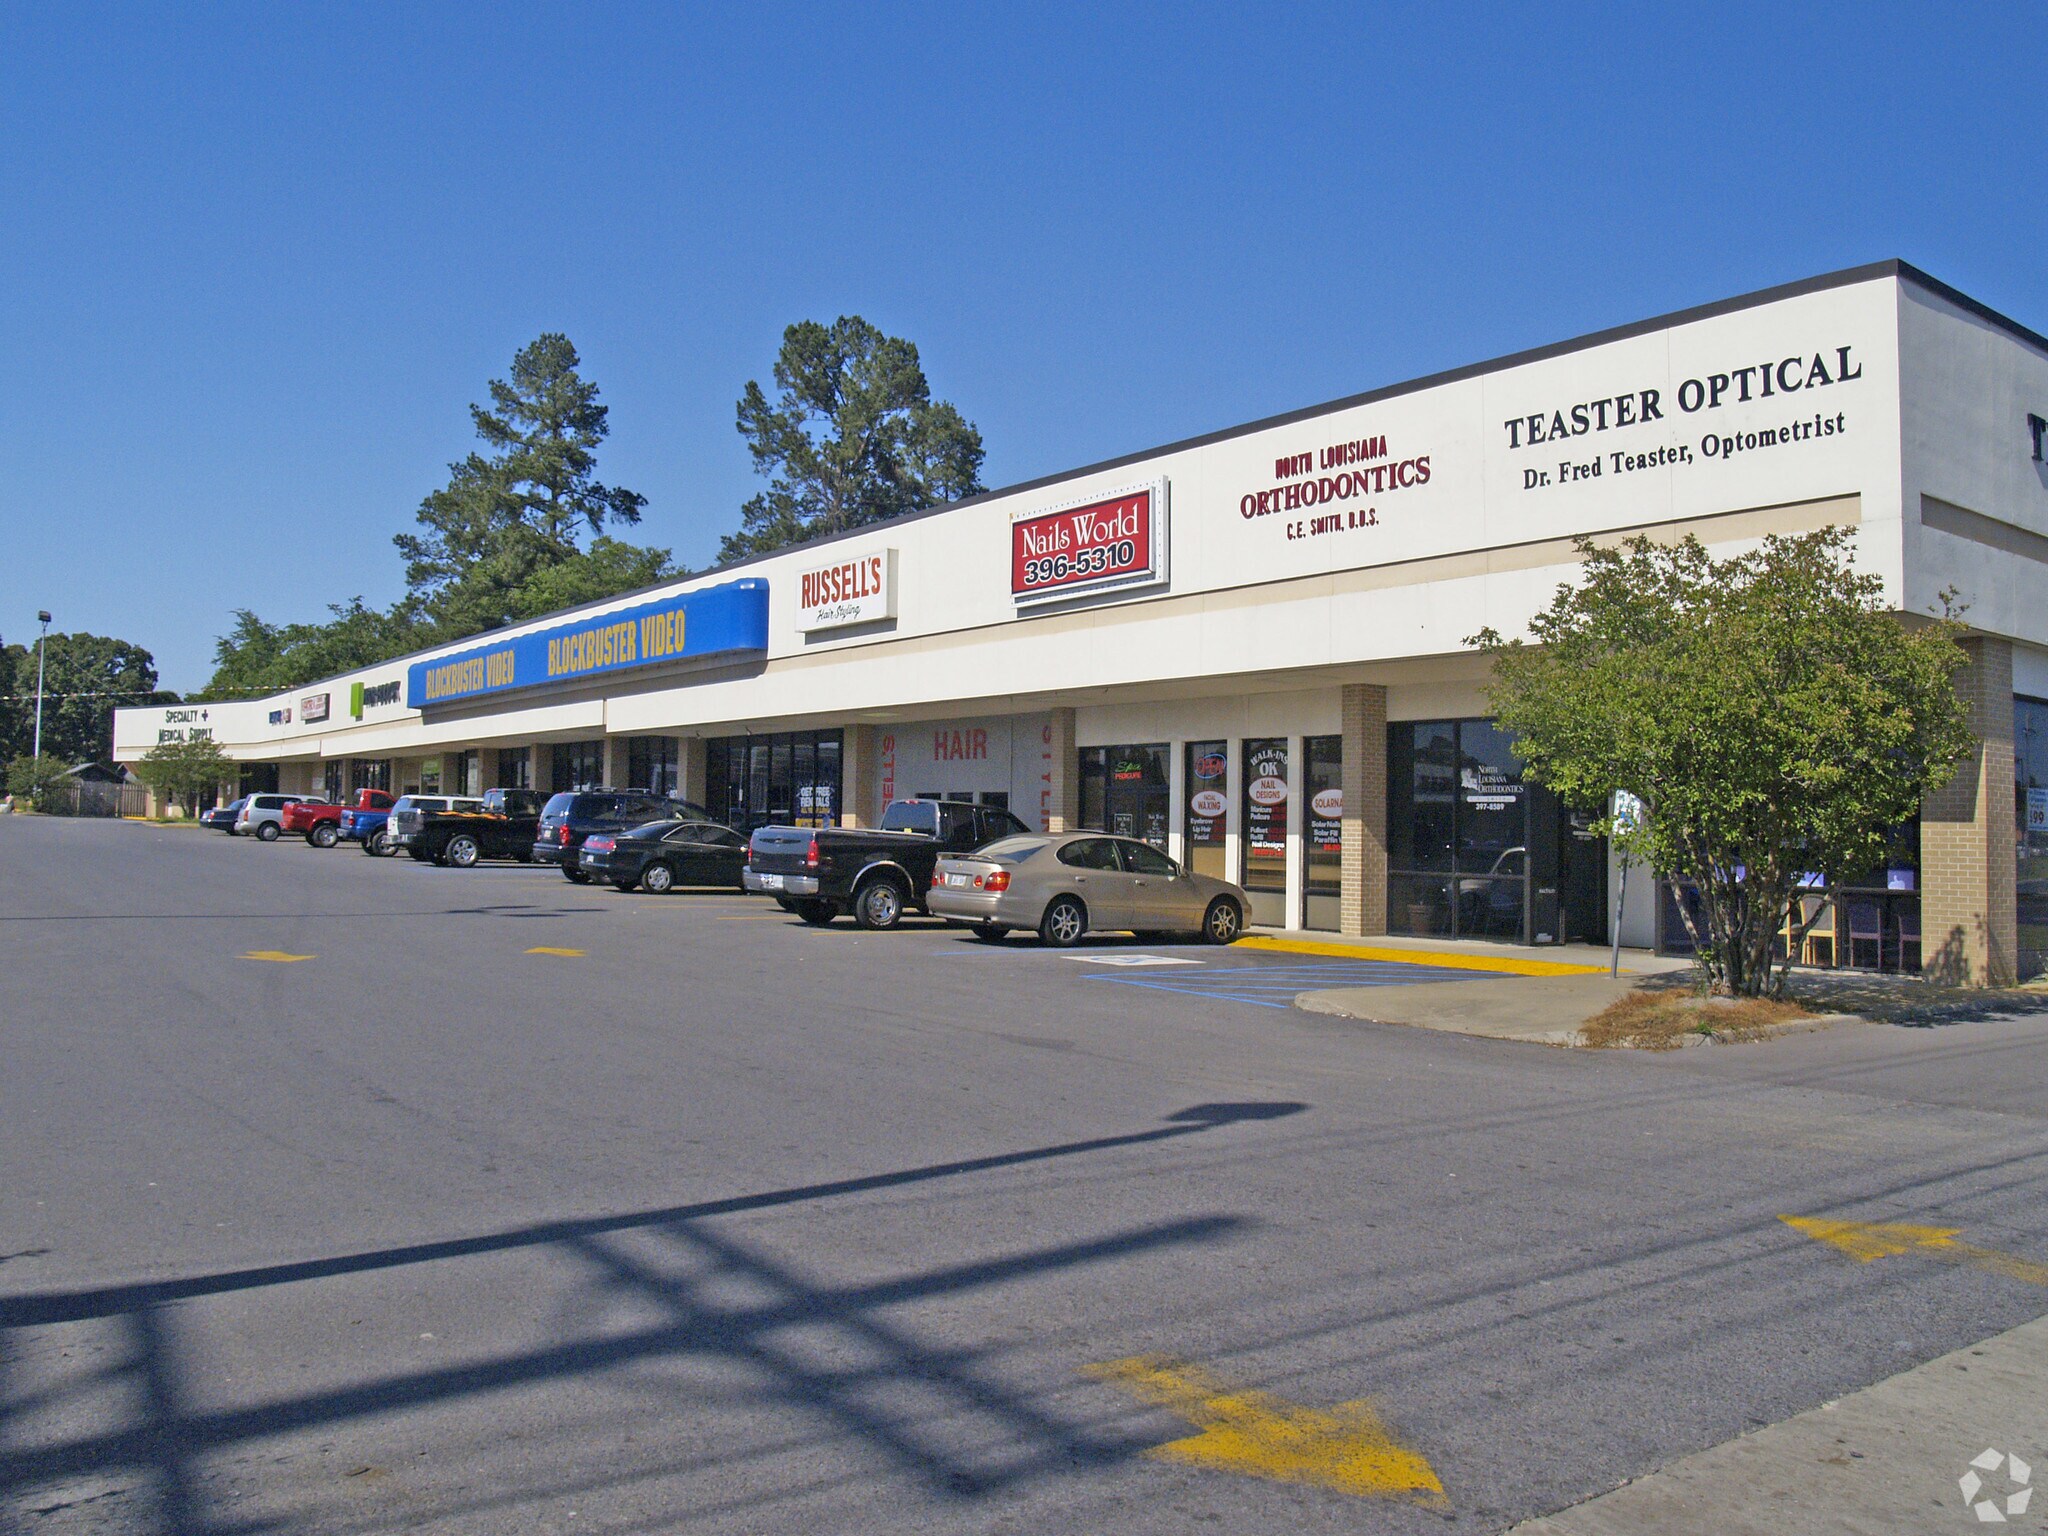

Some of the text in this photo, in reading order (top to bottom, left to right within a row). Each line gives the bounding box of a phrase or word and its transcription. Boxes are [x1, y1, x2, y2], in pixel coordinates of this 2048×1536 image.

[1504, 345, 1862, 449] TEASTER OPTICAL
[1524, 412, 1845, 490] Dr. Fred Teaster, Optometrist
[2027, 413, 2048, 465] T
[1275, 435, 1388, 480] NORTH LOUISIANA
[1240, 456, 1431, 520] ORTHODONTICS
[1022, 503, 1139, 558] Nails World
[1287, 507, 1380, 540] C.E. SMITH, D.D.S.
[1024, 539, 1135, 585] 396-5310
[801, 557, 881, 609] RUSSELL'S
[816, 604, 862, 622] Hair Styling
[548, 609, 686, 676] BLOCKBUSTER VIDEO
[426, 658, 484, 699] BLOCKBUSTER
[486, 650, 514, 687] VIDEO
[158, 727, 213, 744] MEDICAL SUPPLY
[934, 728, 987, 761] HAIR
[1194, 757, 1225, 775] OPEN
[1250, 749, 1288, 766] WALK-INS
[1260, 761, 1278, 776] OK
[1256, 790, 1280, 799] DESIGNS
[1261, 781, 1276, 789] NAIL
[1197, 801, 1221, 811] WAXING
[1263, 841, 1285, 850] Designs
